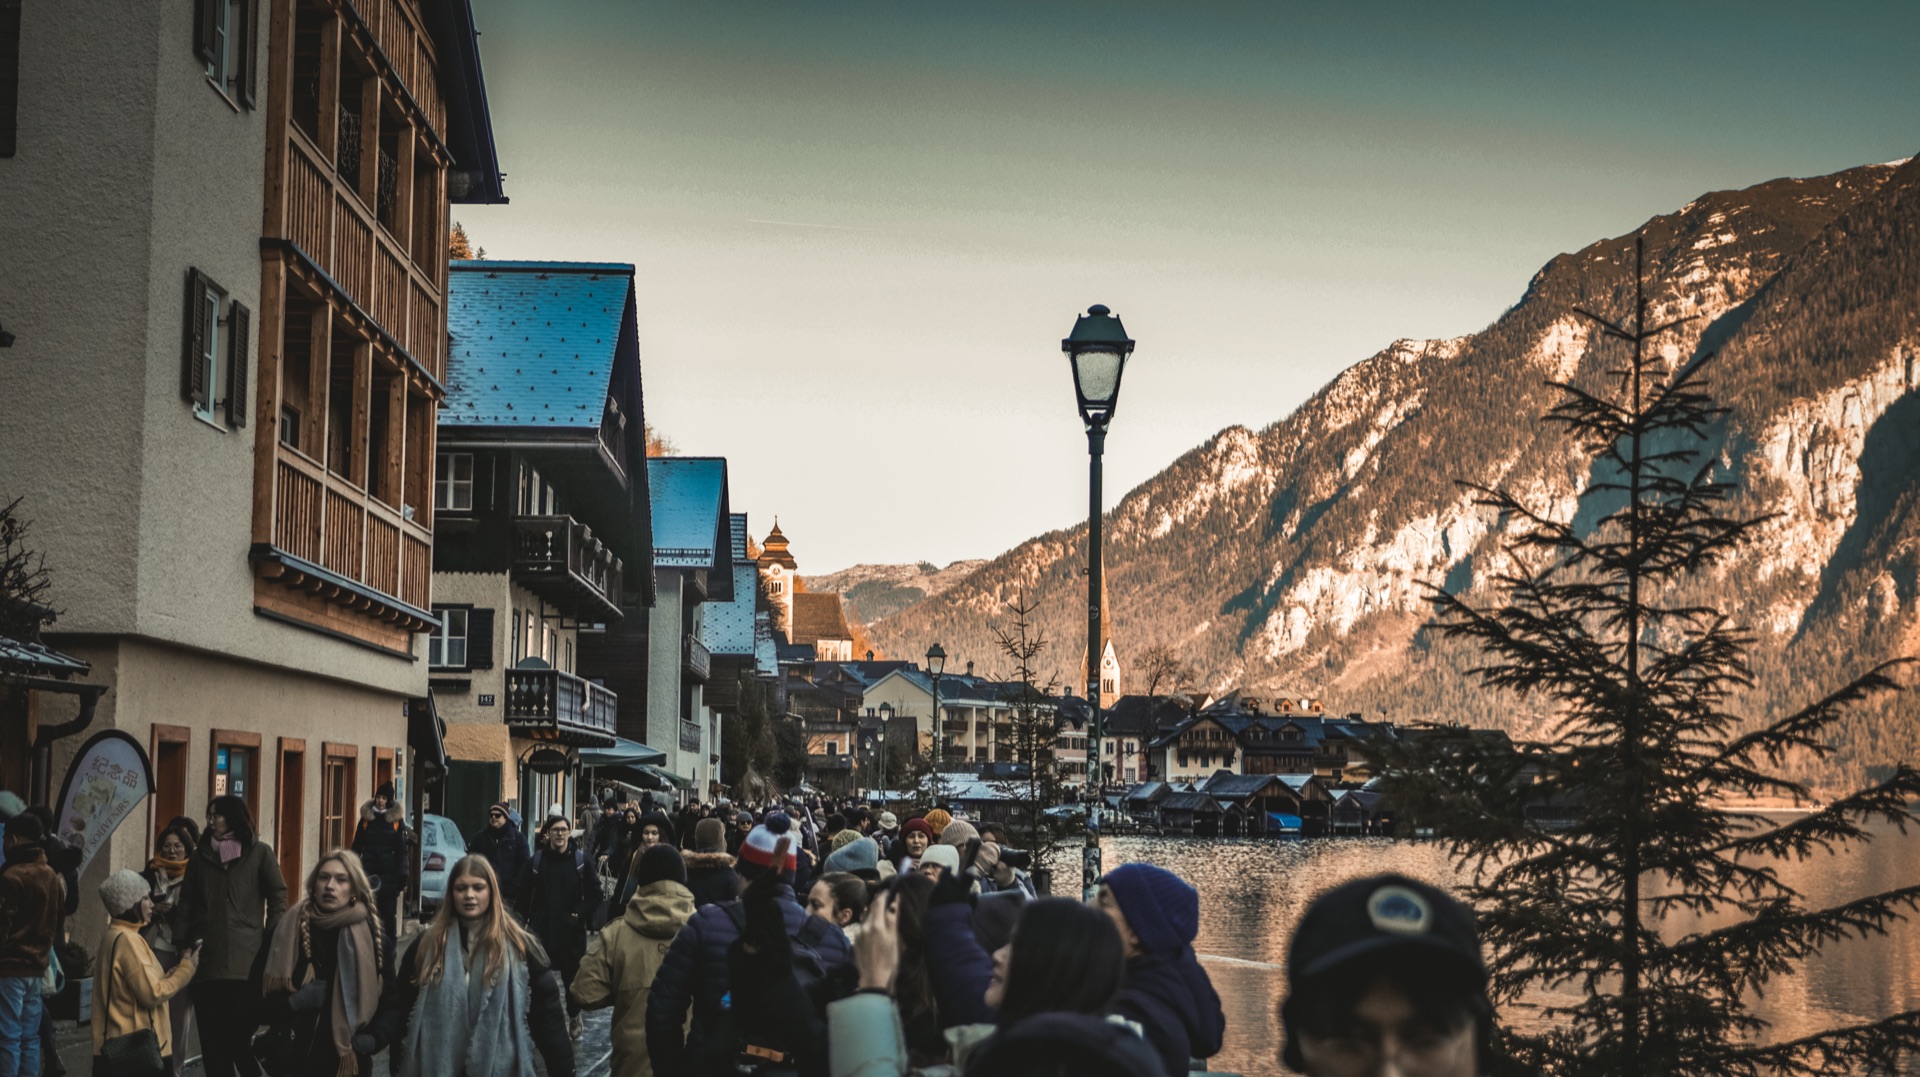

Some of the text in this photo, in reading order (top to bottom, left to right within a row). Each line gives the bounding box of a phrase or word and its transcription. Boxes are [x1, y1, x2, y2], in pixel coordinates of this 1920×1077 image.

[480, 695, 493, 703] 147
[91, 755, 139, 789] 纪念品
[234, 780, 244, 792] ATM
[90, 798, 130, 848] SOUVENIRS
